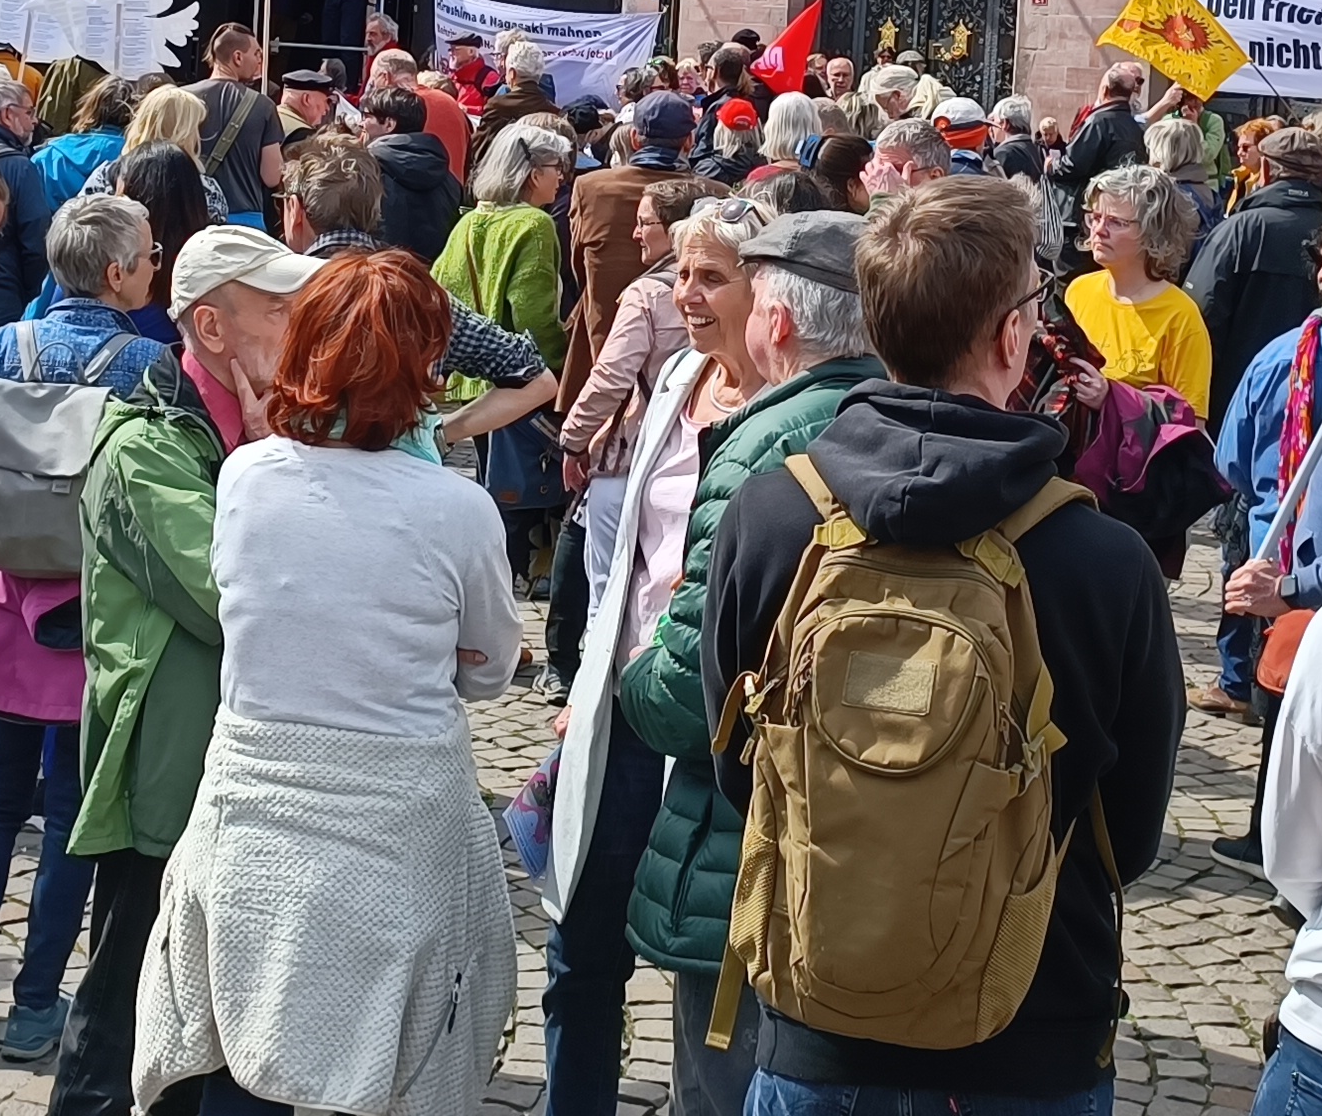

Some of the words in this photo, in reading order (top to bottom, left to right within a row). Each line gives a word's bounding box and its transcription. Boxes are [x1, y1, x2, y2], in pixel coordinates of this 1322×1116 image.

[479, 12, 488, 25] &
[547, 26, 602, 39] mahnen
[1249, 37, 1322, 71] nicht
